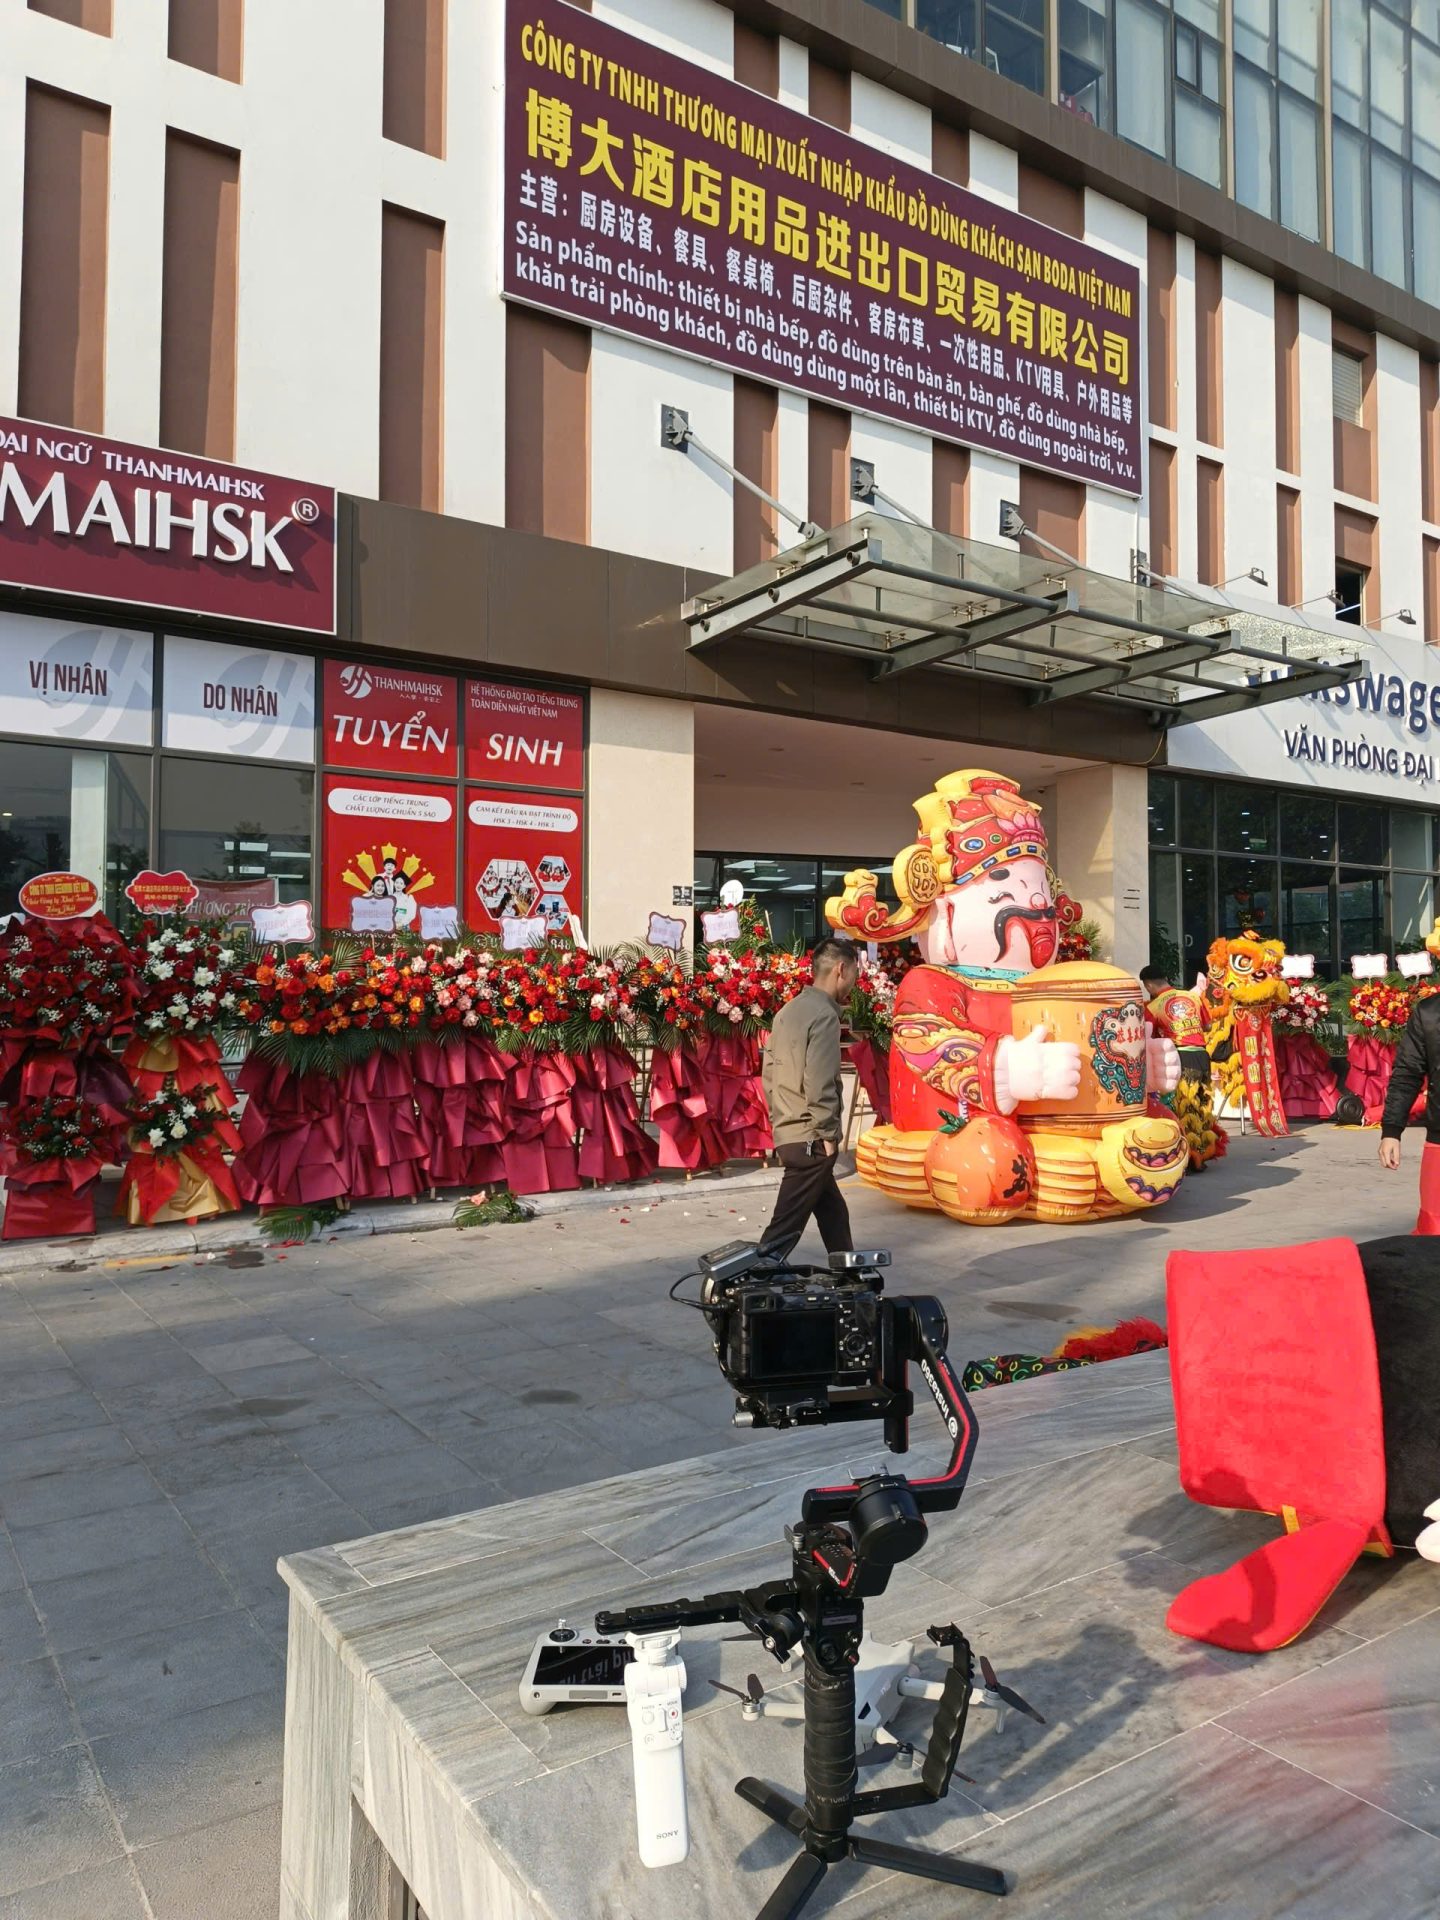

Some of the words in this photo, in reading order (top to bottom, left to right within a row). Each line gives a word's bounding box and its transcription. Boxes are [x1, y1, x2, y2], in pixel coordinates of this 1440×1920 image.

[521, 19, 575, 80] CÔNG
[580, 48, 603, 91] TY
[607, 60, 659, 116] TNHH
[663, 86, 737, 150] THƯƠNG
[741, 121, 772, 170] MẠI
[776, 136, 818, 185] XUẤT
[821, 156, 863, 209] NHẬP
[866, 174, 905, 223] KHẨU
[908, 188, 928, 231] ĐỒ
[931, 201, 969, 250] DÙNG
[971, 223, 1015, 269] KHÁCH
[1017, 247, 1041, 284] SẠN
[1044, 256, 1077, 296] BODA
[1079, 268, 1104, 313] VIỆT
[1105, 280, 1132, 319] NAM
[525, 87, 1130, 385] 博大酒店用品进出口贸易有限公司
[516, 220, 552, 254] Sản
[558, 238, 612, 275] phẩm
[617, 258, 674, 297] chính:
[678, 280, 721, 314] thiết
[725, 294, 741, 326] bị
[745, 305, 775, 332] nhà
[779, 313, 814, 349] bếp,
[818, 328, 838, 353] đồ
[842, 337, 880, 374] dùng
[884, 353, 913, 380] trên
[917, 362, 942, 390] bàn
[945, 374, 966, 400] ăn,
[970, 380, 994, 407] bàn
[997, 393, 1024, 420] ghế,
[1027, 401, 1043, 423] đồ
[1046, 408, 1077, 440] dùng
[1080, 418, 1101, 443] nhà
[1103, 426, 1128, 455] bếp,
[516, 252, 565, 292] khăn
[571, 274, 605, 305] trải
[610, 289, 669, 332] phòng
[675, 306, 731, 351] khách,
[736, 329, 757, 356] đồ
[762, 339, 803, 376] dùng
[807, 354, 846, 391] dùng
[851, 373, 881, 399] một
[884, 378, 910, 410] lần,
[914, 390, 948, 419] thiết
[950, 401, 963, 428] bị
[967, 407, 996, 437] KTV,
[999, 418, 1016, 441] đồ
[1019, 425, 1050, 457] dùng
[1054, 440, 1087, 463] ngoài
[1089, 449, 1114, 475] trời,
[1117, 461, 1136, 479] v.v.
[36, 438, 93, 464] NGỮ
[101, 451, 265, 501] THANHMAIHSK
[29, 660, 48, 696] VỊ
[54, 663, 108, 697] NHÂN
[374, 676, 443, 697] THANHMAIHSK
[481, 685, 506, 699] THỐNG
[506, 688, 521, 701] ĐÀO
[536, 693, 556, 705] TIẾNG
[556, 697, 578, 709] TRUNG
[203, 683, 226, 710] DO
[231, 685, 278, 717] NHÂN
[471, 698, 491, 709] TOÀN
[527, 705, 541, 717] VIỆT
[541, 709, 558, 719] NAM
[333, 710, 449, 754] TUYỂN
[486, 733, 564, 766] SINH
[1284, 723, 1326, 763] VĂN
[1332, 733, 1399, 774] PHÒNG
[1404, 751, 1433, 785] ĐẠI
[656, 1829, 679, 1840] SONY
